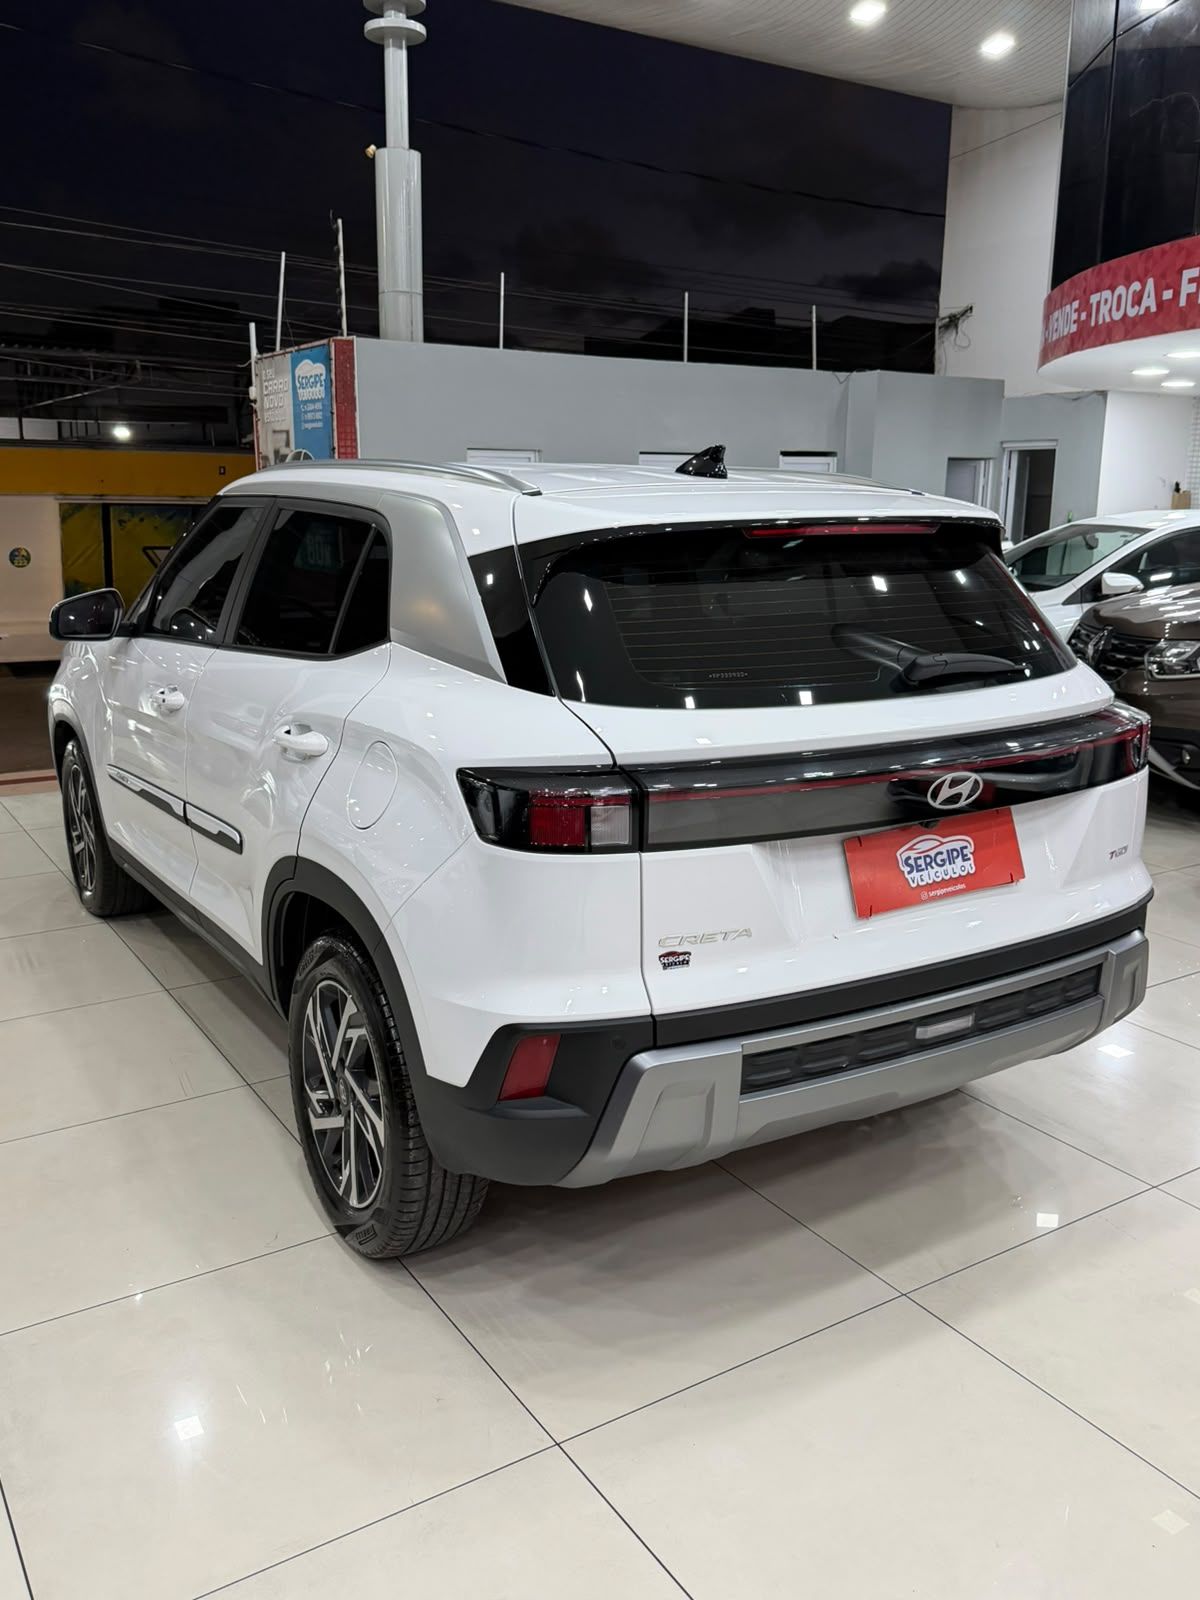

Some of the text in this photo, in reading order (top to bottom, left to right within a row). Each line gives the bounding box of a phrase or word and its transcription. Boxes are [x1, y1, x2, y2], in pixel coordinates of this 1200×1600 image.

[1048, 299, 1080, 343] VENDE
[1089, 277, 1157, 327] TROCA
[1179, 267, 1200, 308] F
[297, 373, 324, 390] SERGIPE
[903, 845, 971, 875] SERGIPE
[658, 928, 752, 948] CRETA
